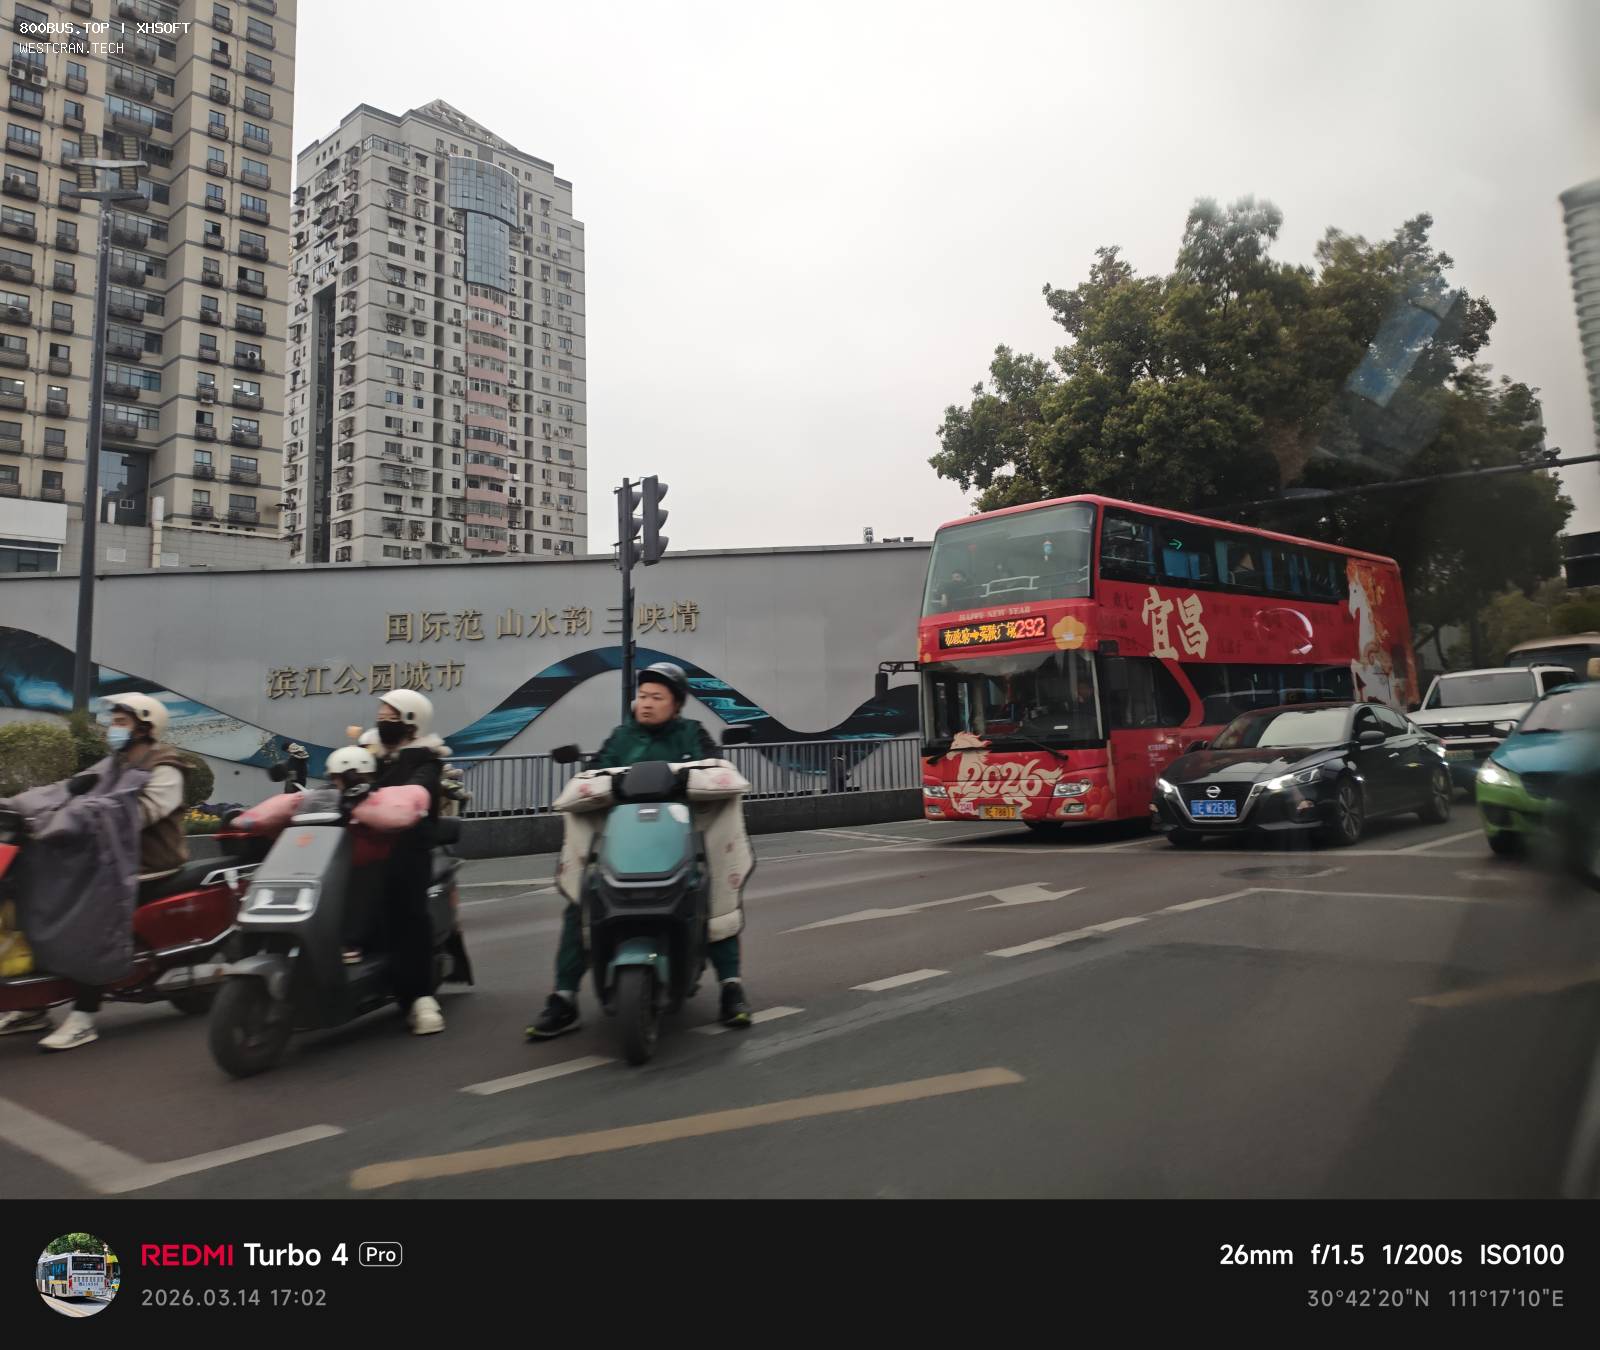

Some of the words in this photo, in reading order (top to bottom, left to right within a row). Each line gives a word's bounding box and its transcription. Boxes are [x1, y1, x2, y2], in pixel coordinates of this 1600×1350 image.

[384, 608, 486, 645] 国际范
[496, 604, 594, 639] 山水韵
[602, 599, 701, 635] 三峡情
[1015, 617, 1045, 638] 292
[1142, 586, 1209, 661] 宜昌
[266, 657, 466, 701] 滨江公园城市
[962, 759, 1043, 798] 2026
